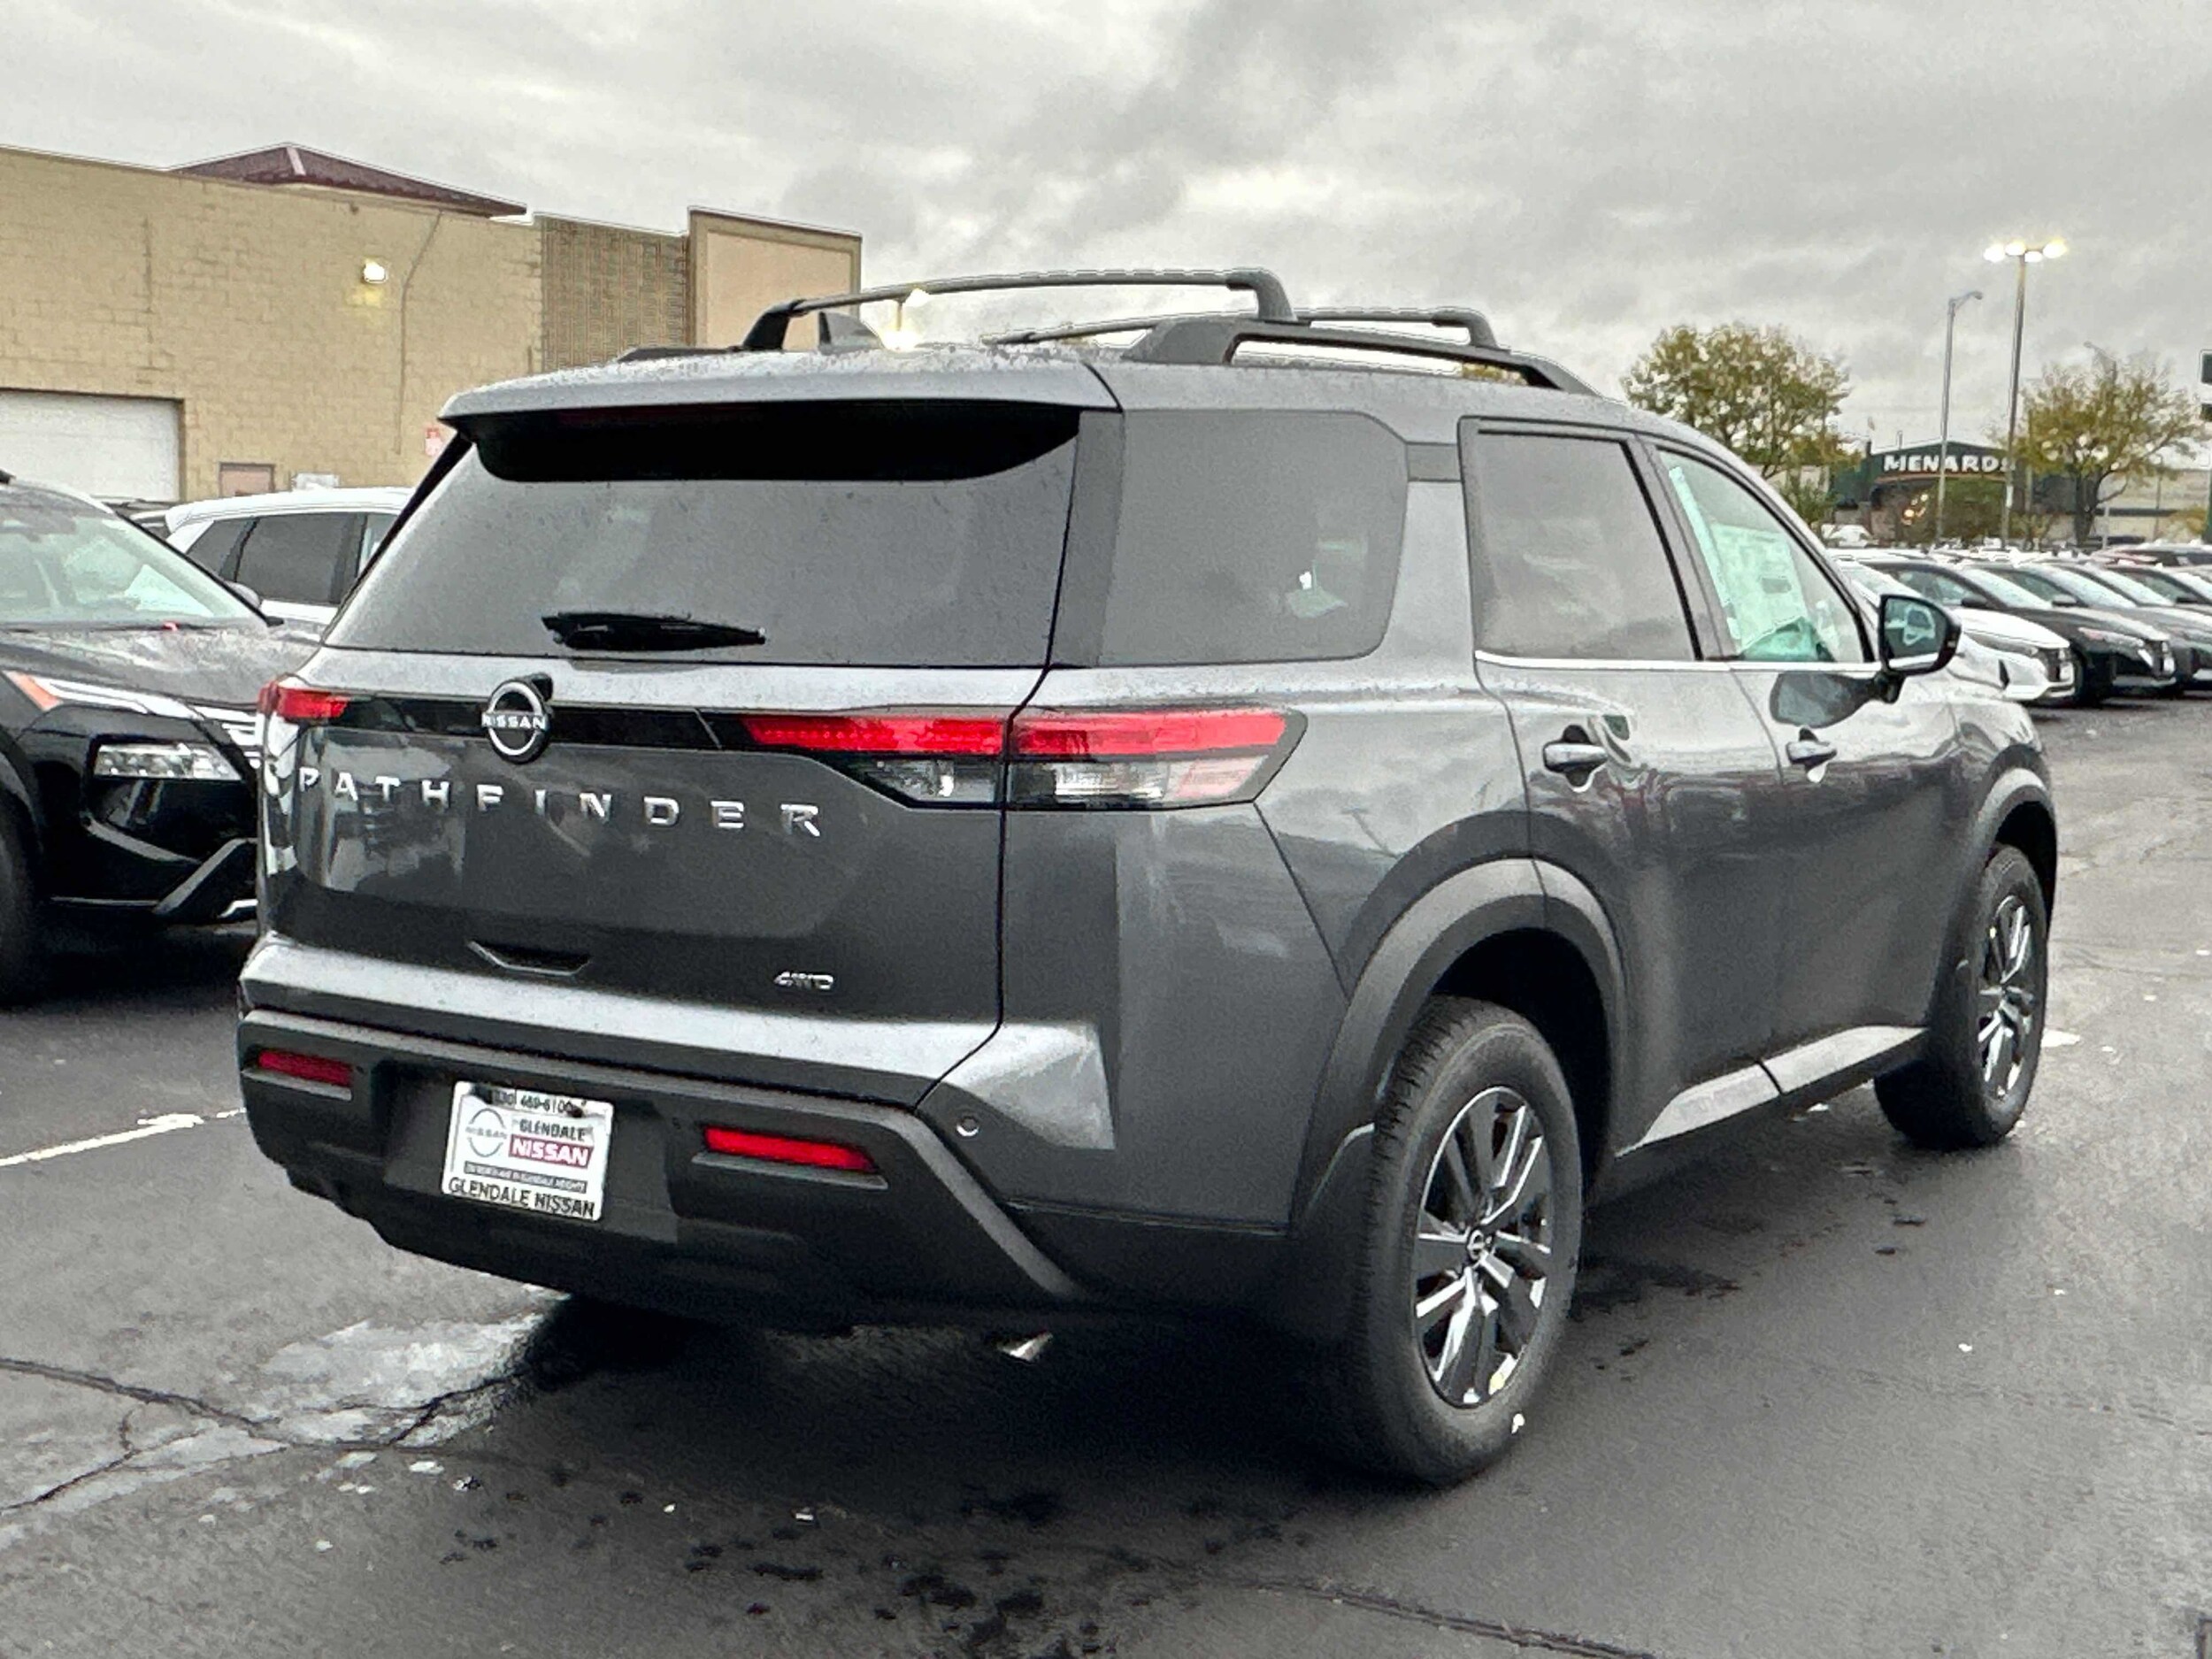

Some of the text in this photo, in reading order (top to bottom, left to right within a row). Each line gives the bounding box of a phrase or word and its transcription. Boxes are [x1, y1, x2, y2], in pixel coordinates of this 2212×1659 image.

[482, 713, 546, 730] NISSAN
[298, 767, 819, 837] PATHFINDER
[519, 1118, 586, 1141] GLENDALE
[511, 1138, 589, 1166] NISSAN
[449, 1177, 531, 1207] GLENDALE
[534, 1192, 595, 1218] NISSAN
